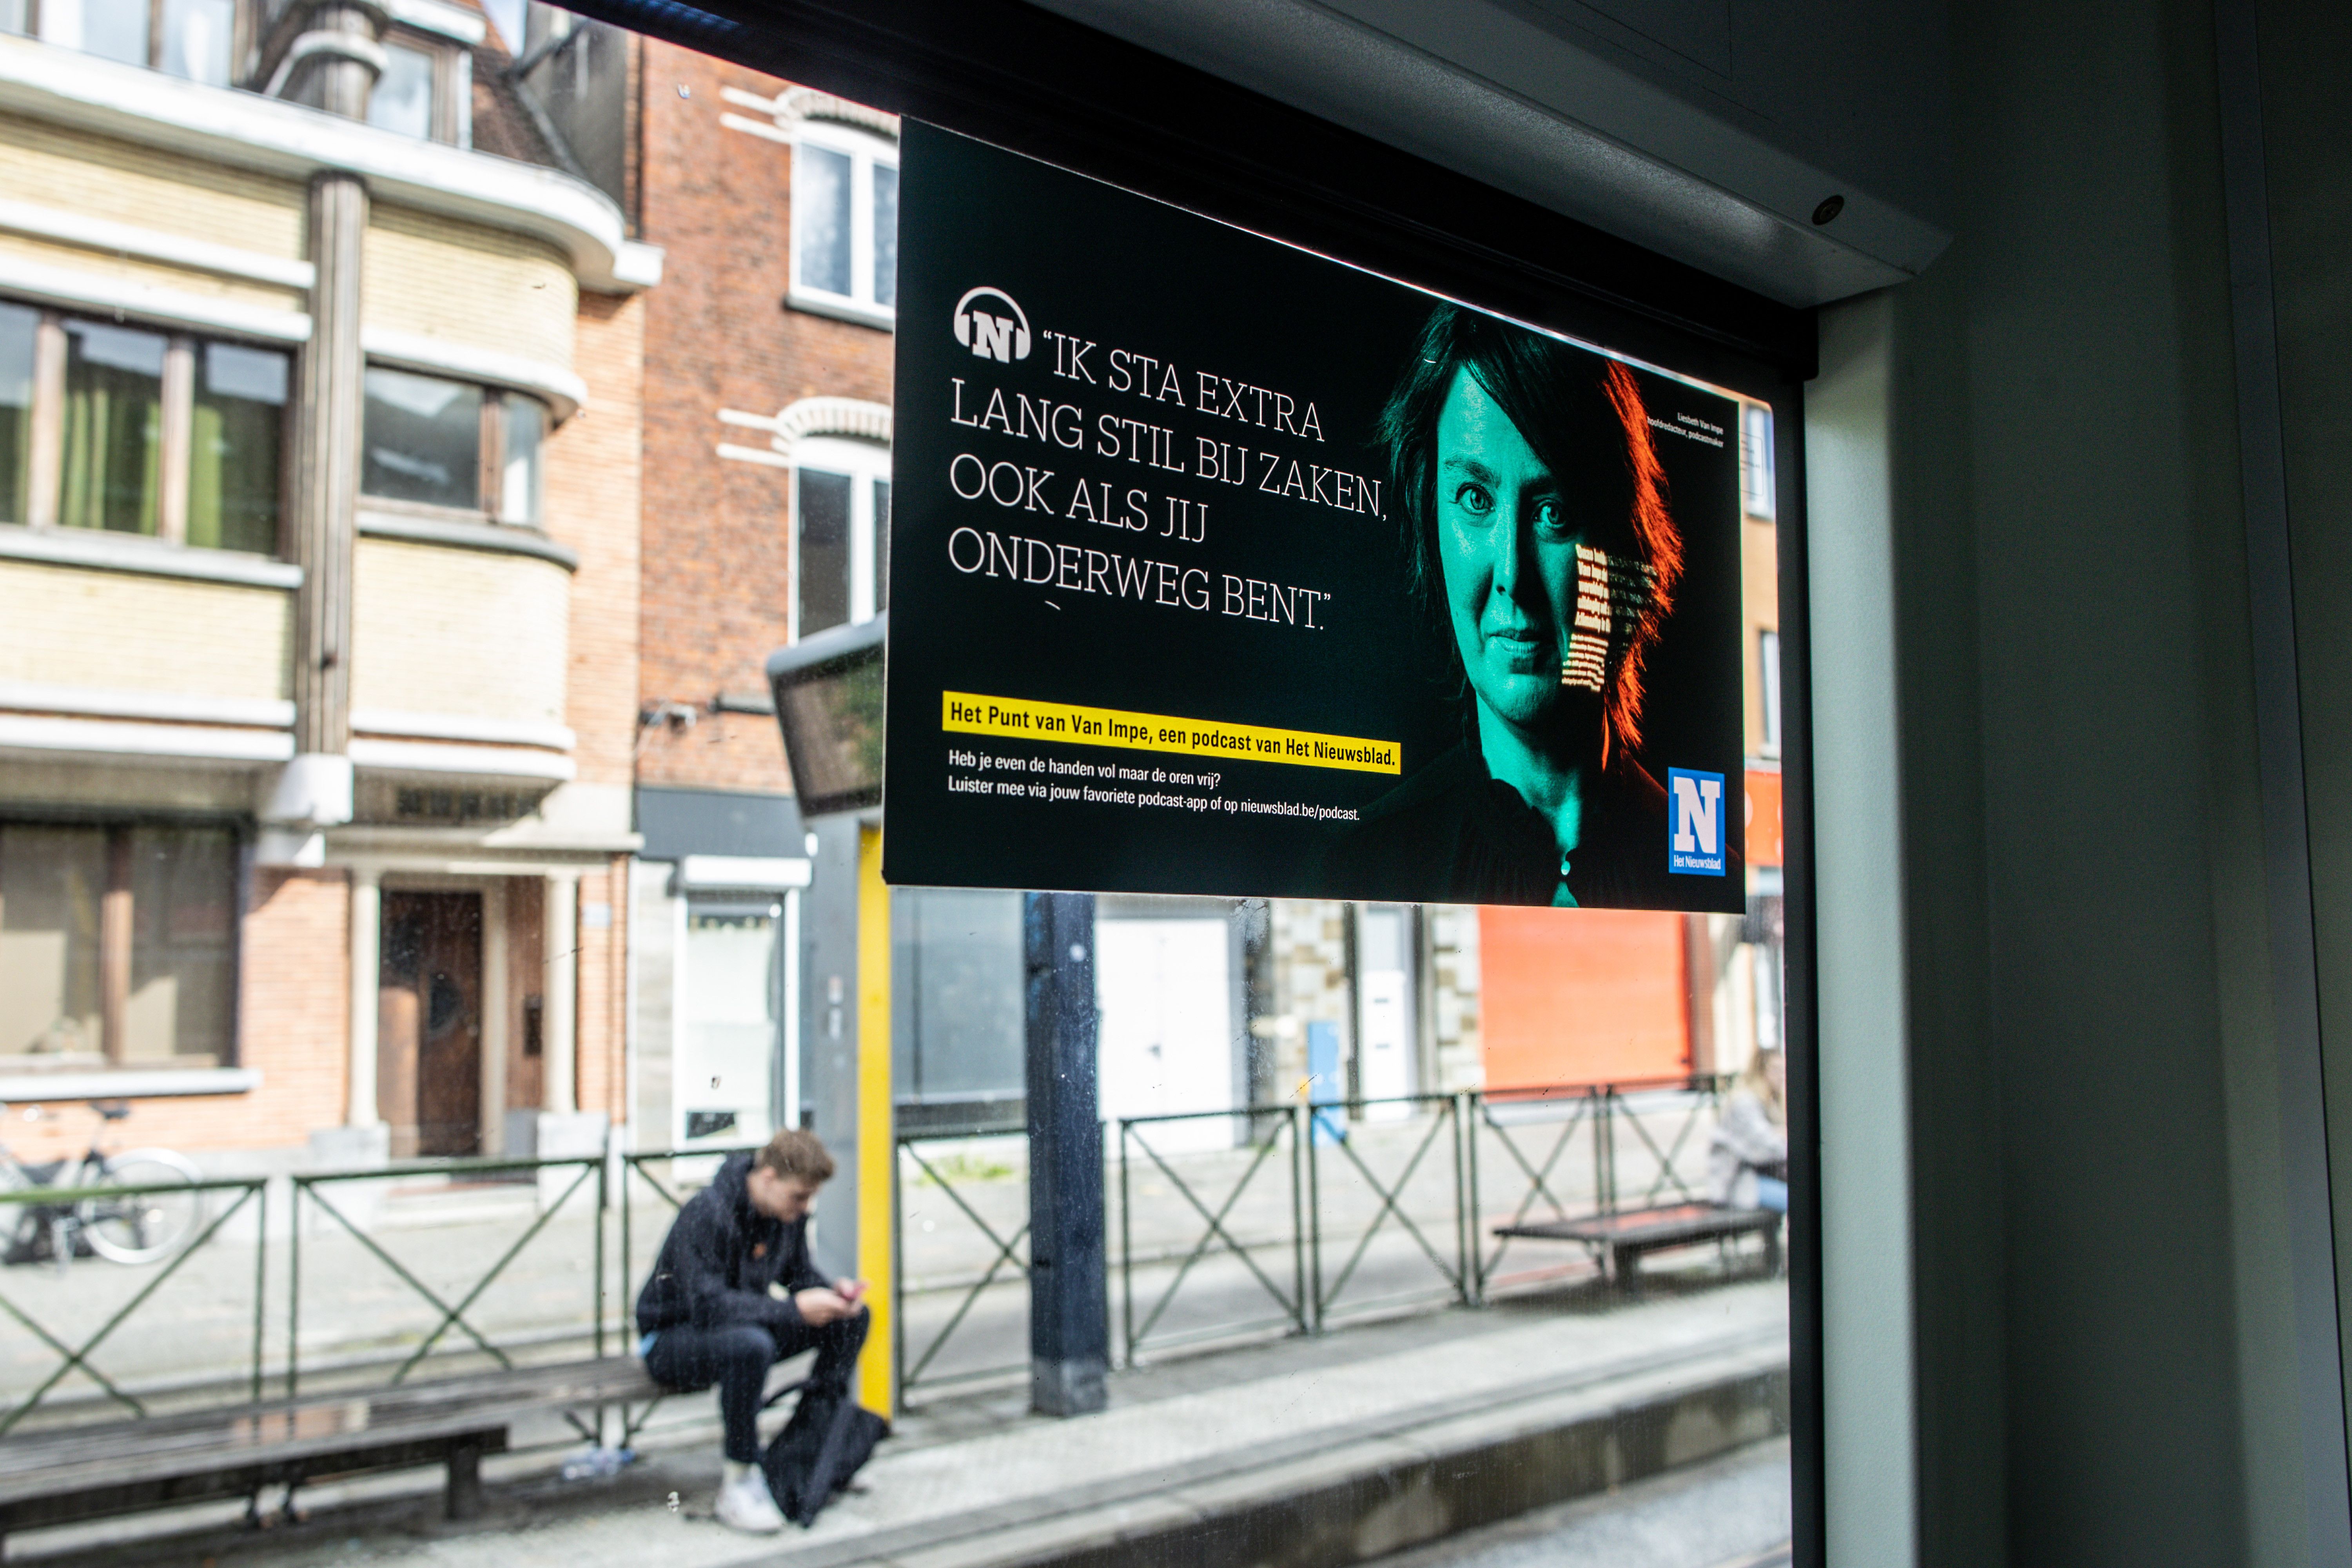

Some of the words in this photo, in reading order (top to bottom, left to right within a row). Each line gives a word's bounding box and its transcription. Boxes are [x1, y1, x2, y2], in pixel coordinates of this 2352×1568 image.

[971, 309, 1014, 364] N
[1109, 348, 1186, 407] STA
[1196, 370, 1325, 443] EXTRA
[950, 377, 1083, 450] LANG
[1097, 414, 1185, 473] STIL
[1195, 436, 1249, 486] BIJ
[1258, 452, 1387, 521] ZAKEN,
[949, 453, 1055, 515] OOK
[1065, 477, 1148, 532] ALS
[1160, 496, 1209, 543] JIJ
[948, 526, 1210, 612] ONDERWEG
[949, 749, 976, 768] Heb
[978, 751, 992, 772] je
[995, 757, 1026, 771] even
[1029, 756, 1046, 773] de
[1049, 757, 1095, 777] handen
[1097, 763, 1116, 779] vol
[1118, 768, 1150, 781] maar
[1151, 767, 1167, 783] de
[1169, 772, 1194, 785] oren
[1196, 772, 1221, 790] vrij?
[951, 701, 982, 724] Het
[989, 706, 1029, 728] Punt
[1035, 715, 1065, 731] van
[1071, 714, 1102, 735] Van
[1109, 718, 1153, 744] Impe,
[1159, 728, 1186, 744] een
[1192, 730, 1251, 751] podcast
[1256, 739, 1281, 754] van
[1286, 738, 1310, 757] Het
[1314, 741, 1395, 766] Nieuwsblad.
[948, 775, 994, 794] Luister
[996, 782, 1025, 797] mee
[1027, 781, 1047, 798] via
[1048, 782, 1081, 802] jouw
[1083, 785, 1136, 805] favoriete
[1138, 791, 1208, 813] podcast-app
[1210, 796, 1222, 810] of
[1223, 800, 1238, 815] op
[1240, 798, 1360, 821] nieuwsblad.be/podcast.
[1673, 776, 1720, 854] N
[1673, 855, 1684, 867] Het
[1685, 855, 1721, 870] Nieuwsblad
